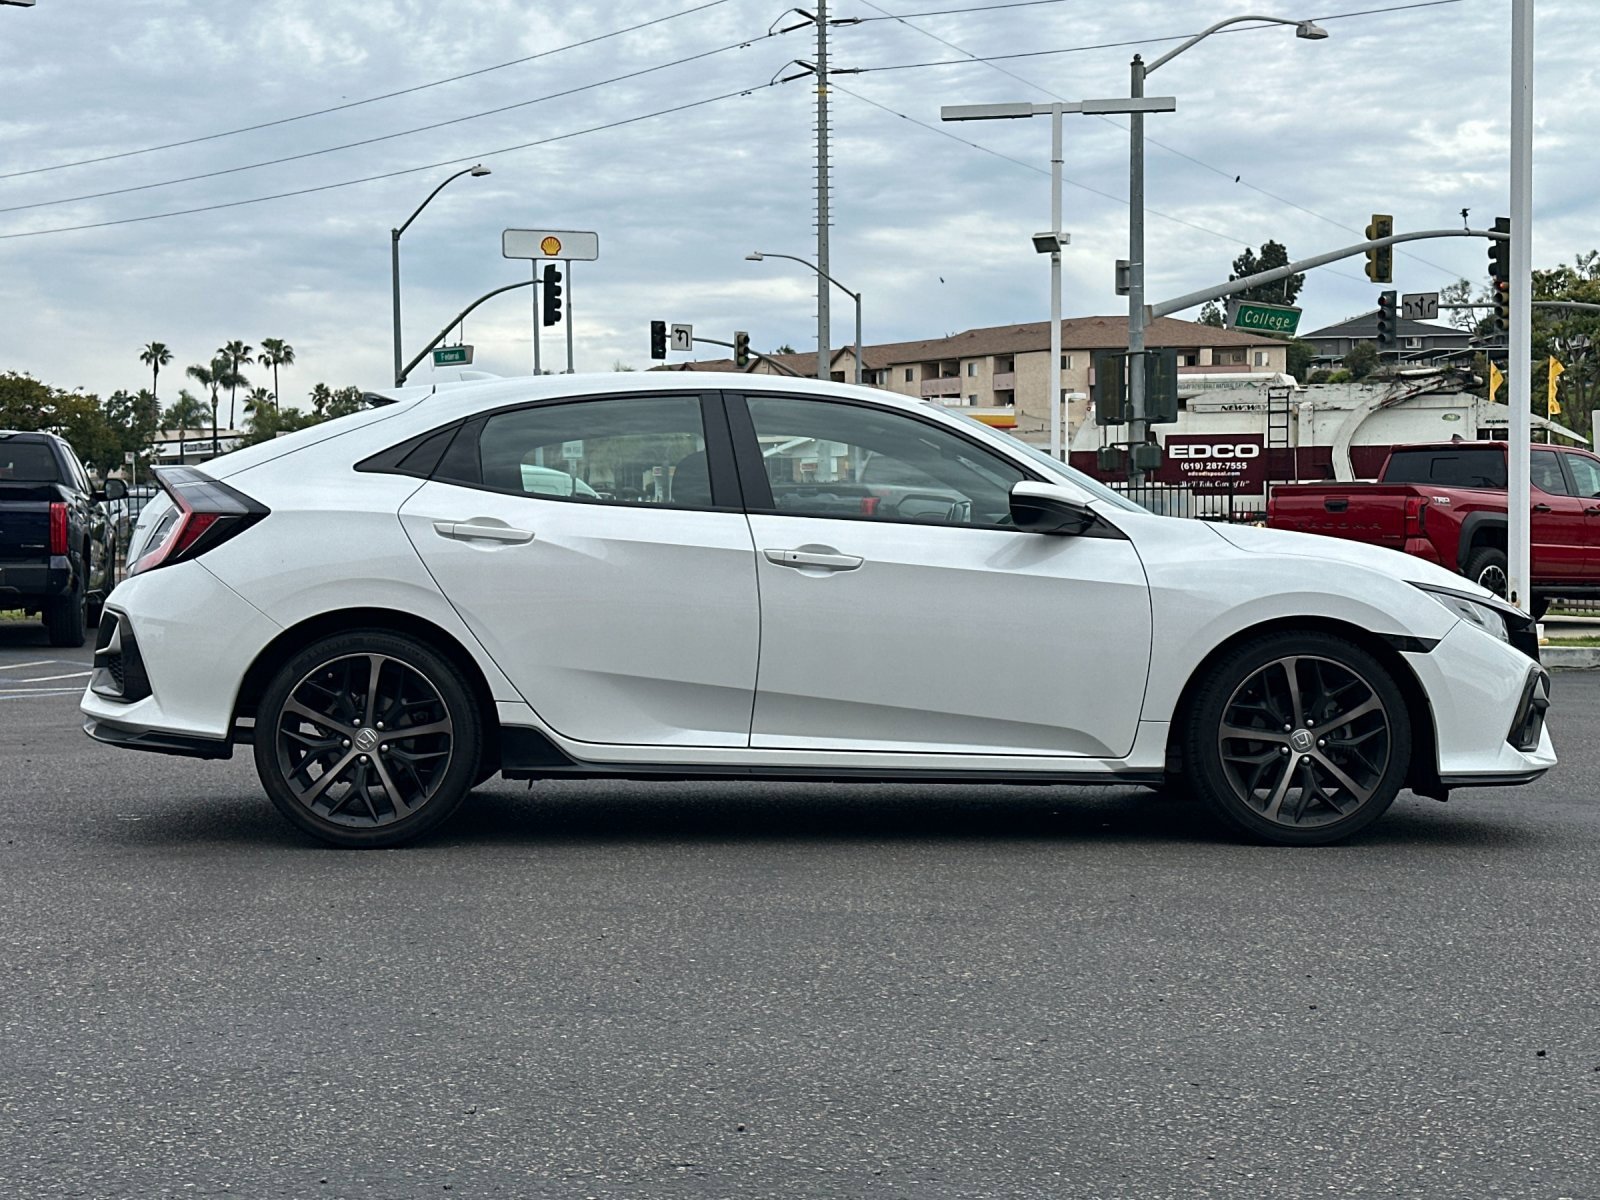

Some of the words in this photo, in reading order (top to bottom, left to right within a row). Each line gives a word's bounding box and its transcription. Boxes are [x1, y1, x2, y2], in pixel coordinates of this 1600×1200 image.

[1245, 310, 1290, 330] College
[1169, 444, 1259, 459] EDCO
[1181, 462, 1203, 471] (619)
[1206, 462, 1248, 470] 287-7555
